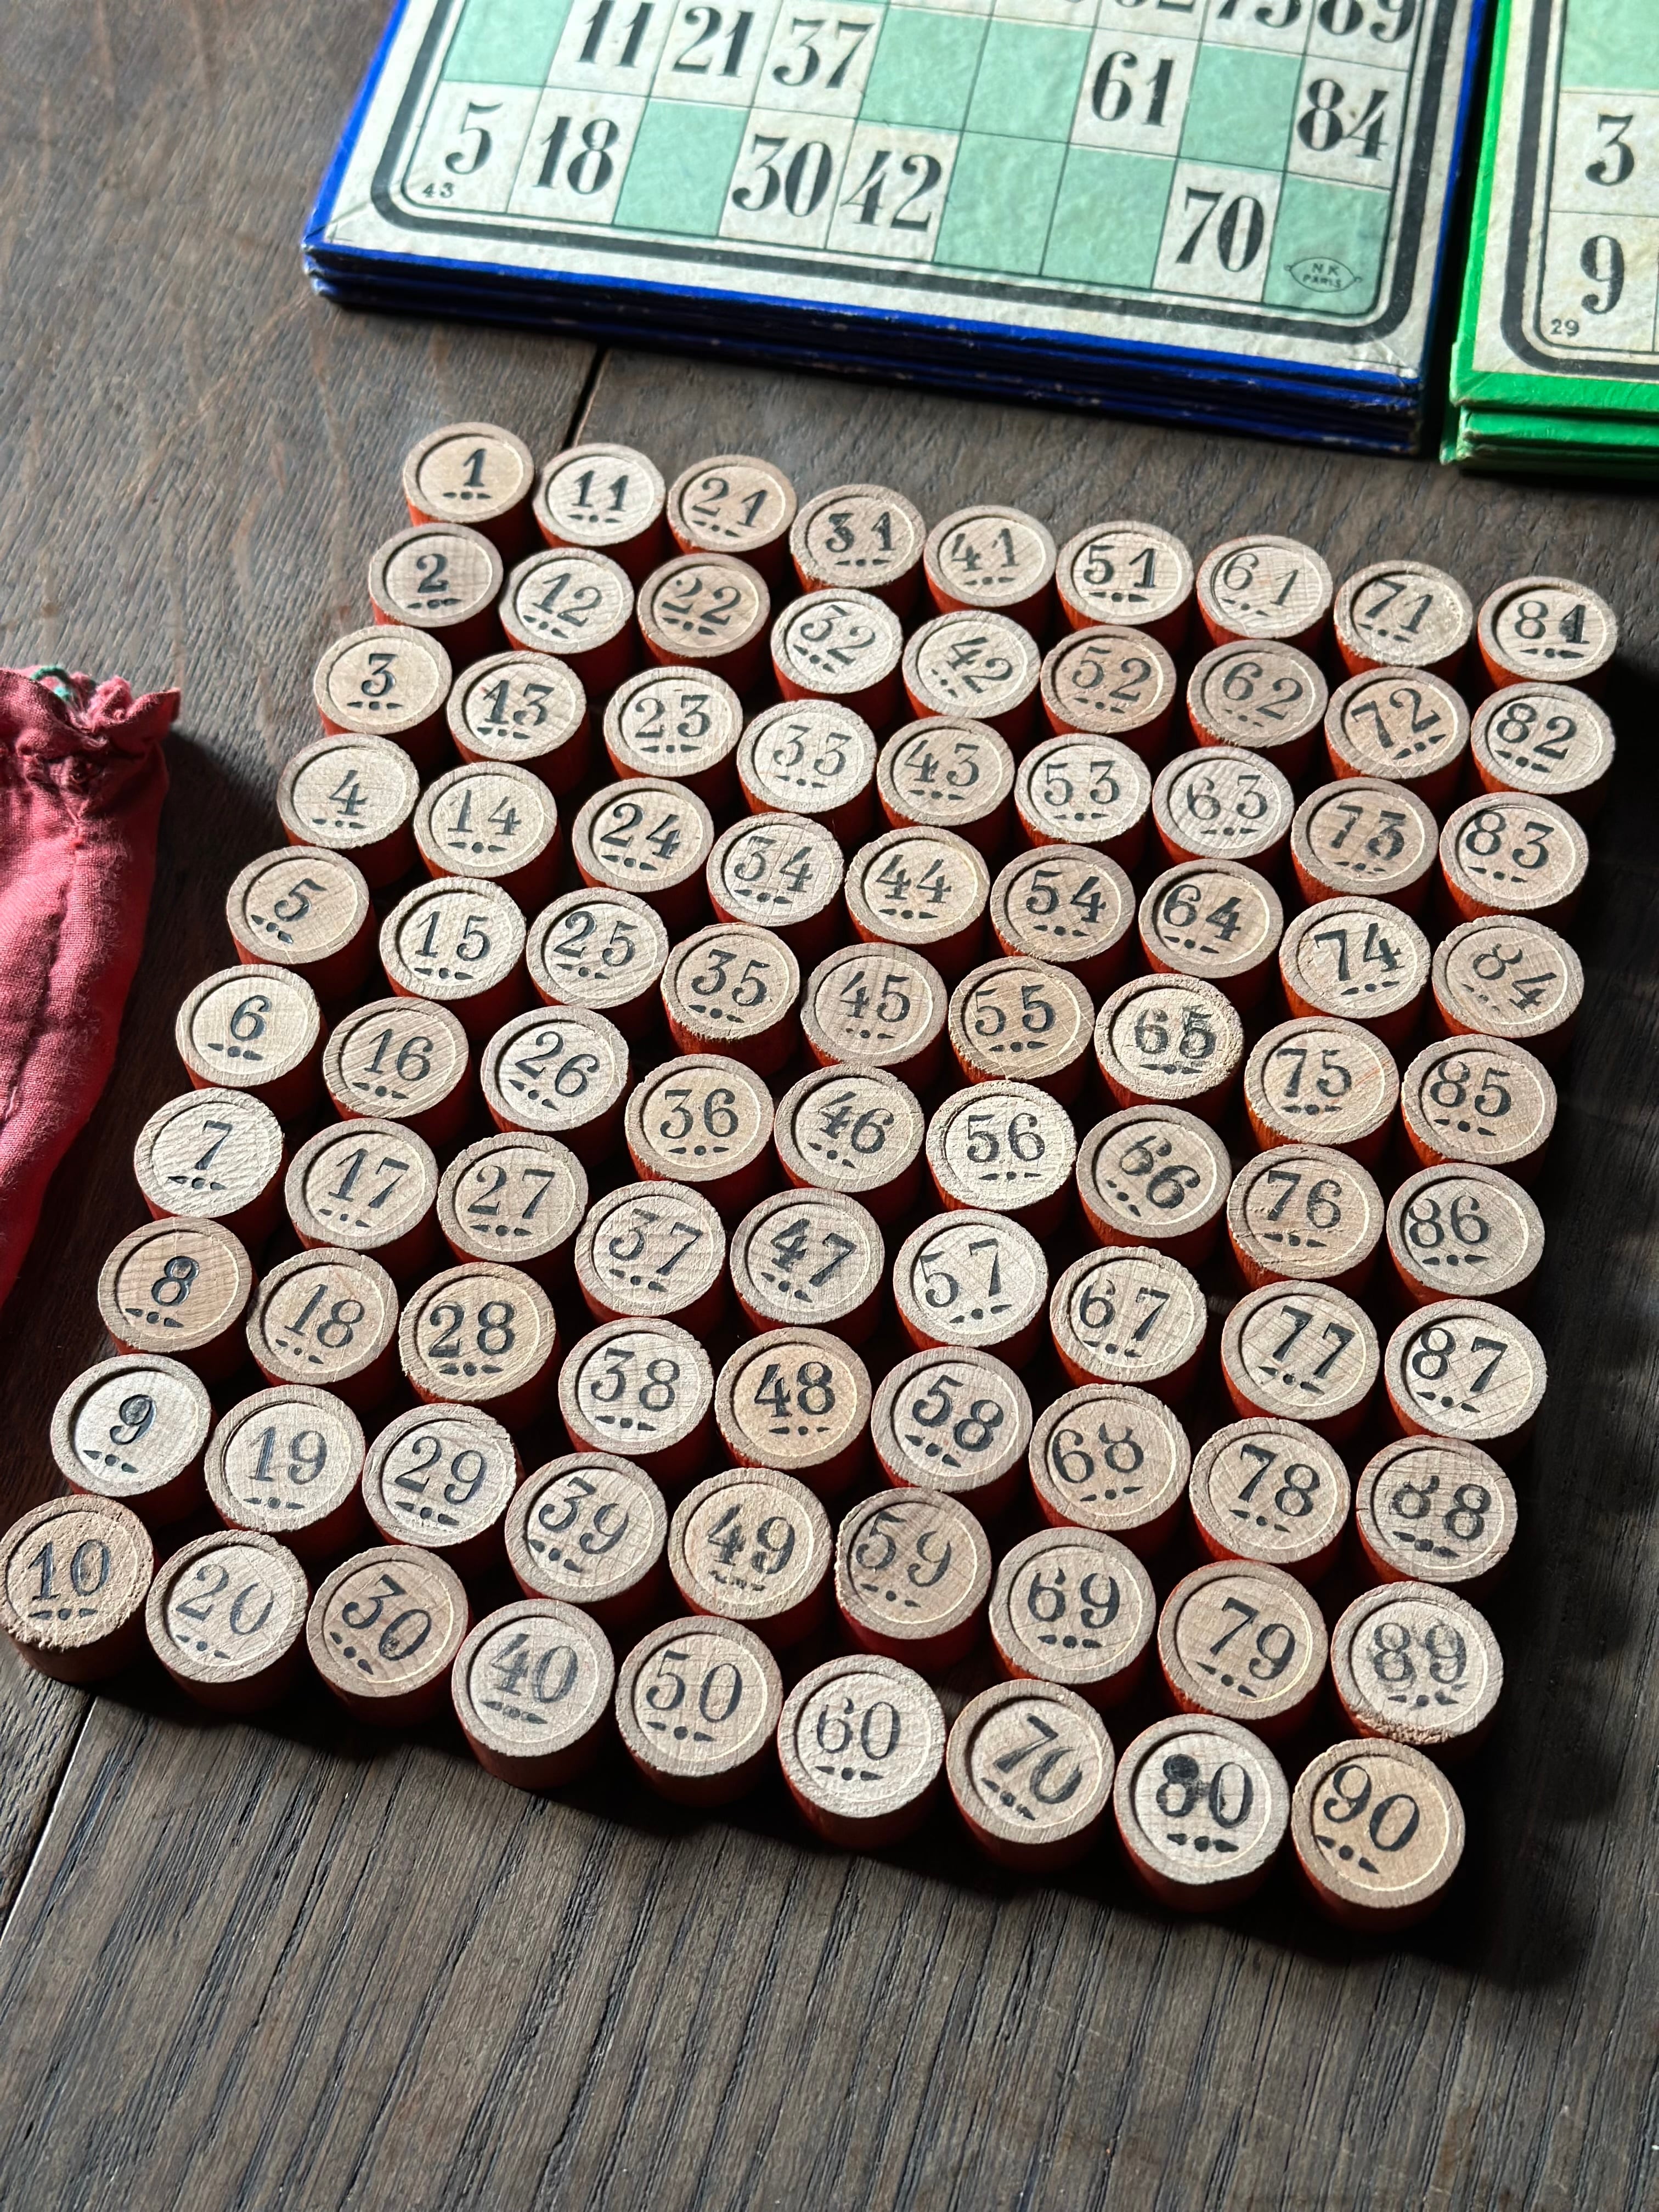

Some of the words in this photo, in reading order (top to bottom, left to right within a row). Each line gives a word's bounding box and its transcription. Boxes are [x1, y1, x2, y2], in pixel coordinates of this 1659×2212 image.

[575, 0, 655, 68] 11
[672, 7, 751, 78] 21
[772, 18, 876, 89] 37
[1091, 51, 1175, 126] 61
[1297, 78, 1389, 161] 84
[1585, 114, 1635, 187] 3
[422, 182, 455, 199] 43
[445, 101, 503, 174] 5
[535, 116, 618, 194] 18
[732, 134, 832, 217] 30
[840, 150, 942, 230] 42
[1176, 187, 1264, 272] 70
[1580, 235, 1624, 315] 9
[1551, 318, 1579, 337] 29
[464, 449, 485, 487] 1
[573, 471, 628, 511] 11
[692, 477, 767, 527] 21
[825, 512, 894, 552] 31
[952, 528, 1019, 572] 41
[417, 554, 448, 593] 2
[1084, 545, 1156, 588] 51
[1223, 554, 1298, 606] 61
[532, 573, 602, 627] 12
[662, 577, 741, 625] 22
[1364, 579, 1434, 634] 71
[1515, 602, 1590, 644] 81
[800, 605, 876, 665] 32
[361, 653, 397, 697] 3
[946, 637, 1013, 693] 42
[1072, 647, 1151, 701] 52
[1223, 662, 1303, 720] 62
[483, 680, 555, 726] 13
[636, 695, 710, 737] 23
[1351, 688, 1441, 748] 72
[1497, 703, 1577, 760] 82
[773, 725, 852, 776] 33
[905, 741, 979, 786] 43
[329, 770, 368, 816] 4
[1045, 760, 1120, 806] 53
[1187, 775, 1268, 820] 63
[448, 789, 521, 835] 14
[600, 803, 680, 860] 24
[1331, 805, 1406, 860] 73
[1466, 811, 1554, 869] 83
[734, 836, 813, 893] 34
[876, 855, 951, 904] 44
[274, 878, 326, 922] 5
[1026, 870, 1106, 923] 54
[1164, 884, 1242, 942] 64
[415, 911, 490, 961] 15
[554, 911, 635, 967] 25
[1314, 923, 1405, 981] 74
[691, 949, 770, 1006] 35
[839, 971, 910, 1022] 45
[1473, 944, 1557, 1011] 84
[230, 995, 269, 1041] 6
[975, 985, 1056, 1036] 55
[1134, 1005, 1217, 1059] 65
[364, 1029, 433, 1081] 16
[515, 1031, 600, 1097] 26
[1277, 1048, 1352, 1097] 75
[660, 1088, 738, 1139] 36
[1429, 1060, 1512, 1118] 85
[193, 1120, 233, 1170] 7
[819, 1092, 895, 1154] 46
[967, 1113, 1045, 1163] 56
[328, 1148, 409, 1209] 17
[467, 1166, 555, 1219] 27
[1119, 1136, 1200, 1209] 66
[1267, 1170, 1342, 1228] 76
[609, 1208, 703, 1276] 37
[1409, 1195, 1489, 1248] 86
[151, 1255, 199, 1306] 8
[770, 1218, 857, 1287] 47
[919, 1238, 1002, 1307] 57
[284, 1284, 365, 1348] 18
[428, 1301, 515, 1358] 28
[1080, 1283, 1170, 1342] 67
[1273, 1305, 1355, 1379] 77
[1412, 1328, 1508, 1393] 87
[591, 1347, 680, 1412] 38
[754, 1362, 835, 1418] 48
[110, 1394, 154, 1446] 9
[912, 1375, 1004, 1452] 58
[249, 1426, 327, 1485] 19
[394, 1436, 487, 1505] 29
[1052, 1422, 1144, 1483] 68
[1238, 1443, 1320, 1516] 78
[539, 1477, 629, 1554] 39
[1391, 1476, 1491, 1542] 88
[708, 1504, 795, 1575] 49
[856, 1513, 952, 1587] 59
[27, 1539, 111, 1604] 10
[177, 1564, 275, 1635] 20
[1028, 1569, 1120, 1629] 69
[342, 1574, 432, 1661] 30
[1210, 1597, 1295, 1680] 79
[490, 1634, 578, 1703] 40
[1373, 1621, 1466, 1684] 89
[646, 1649, 742, 1723] 50
[816, 1698, 901, 1760] 60
[993, 1716, 1082, 1804] 70
[1156, 1754, 1254, 1829] 80
[1323, 1764, 1420, 1852] 90
